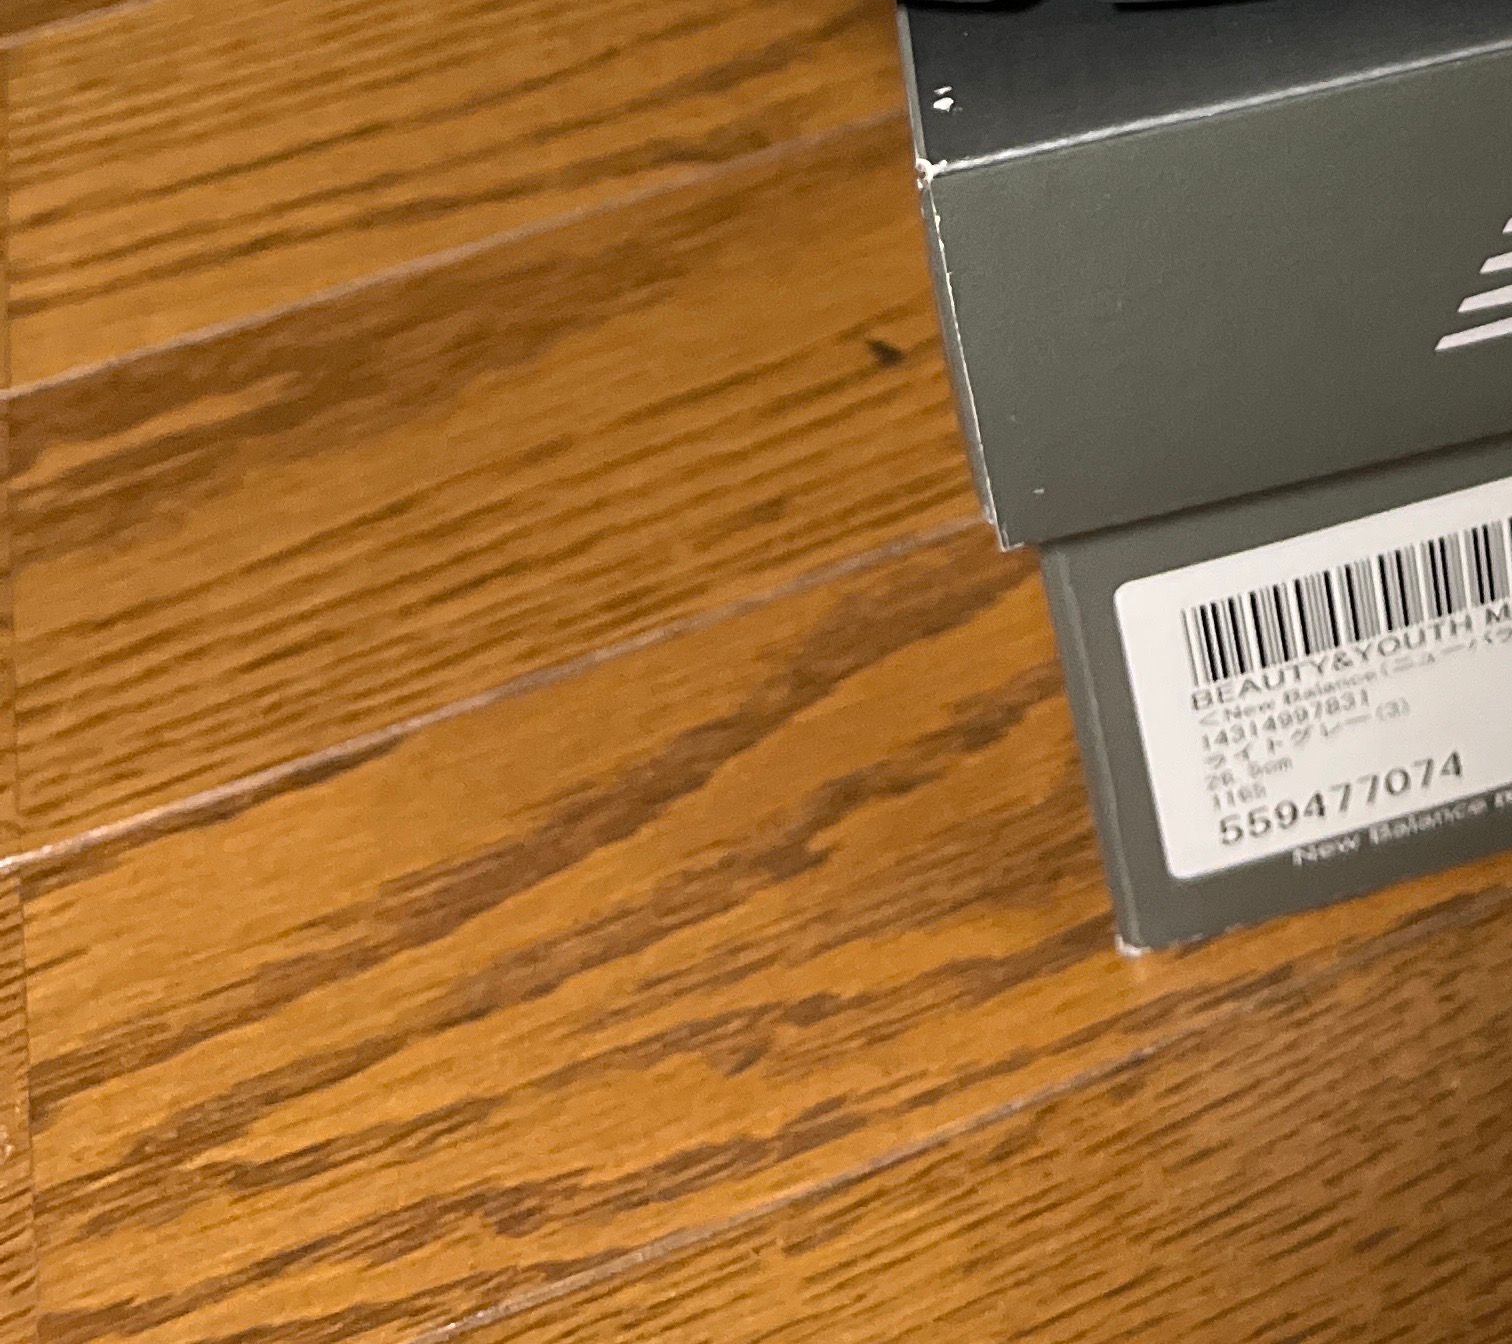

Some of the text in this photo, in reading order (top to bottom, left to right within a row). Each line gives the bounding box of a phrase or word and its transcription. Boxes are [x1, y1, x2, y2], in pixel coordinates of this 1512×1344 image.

[1191, 612, 1472, 712] BEAUTY&YOUTH
[1219, 750, 1463, 846] 559477074
[1291, 834, 1360, 866] New
[1368, 796, 1488, 845] Balance
